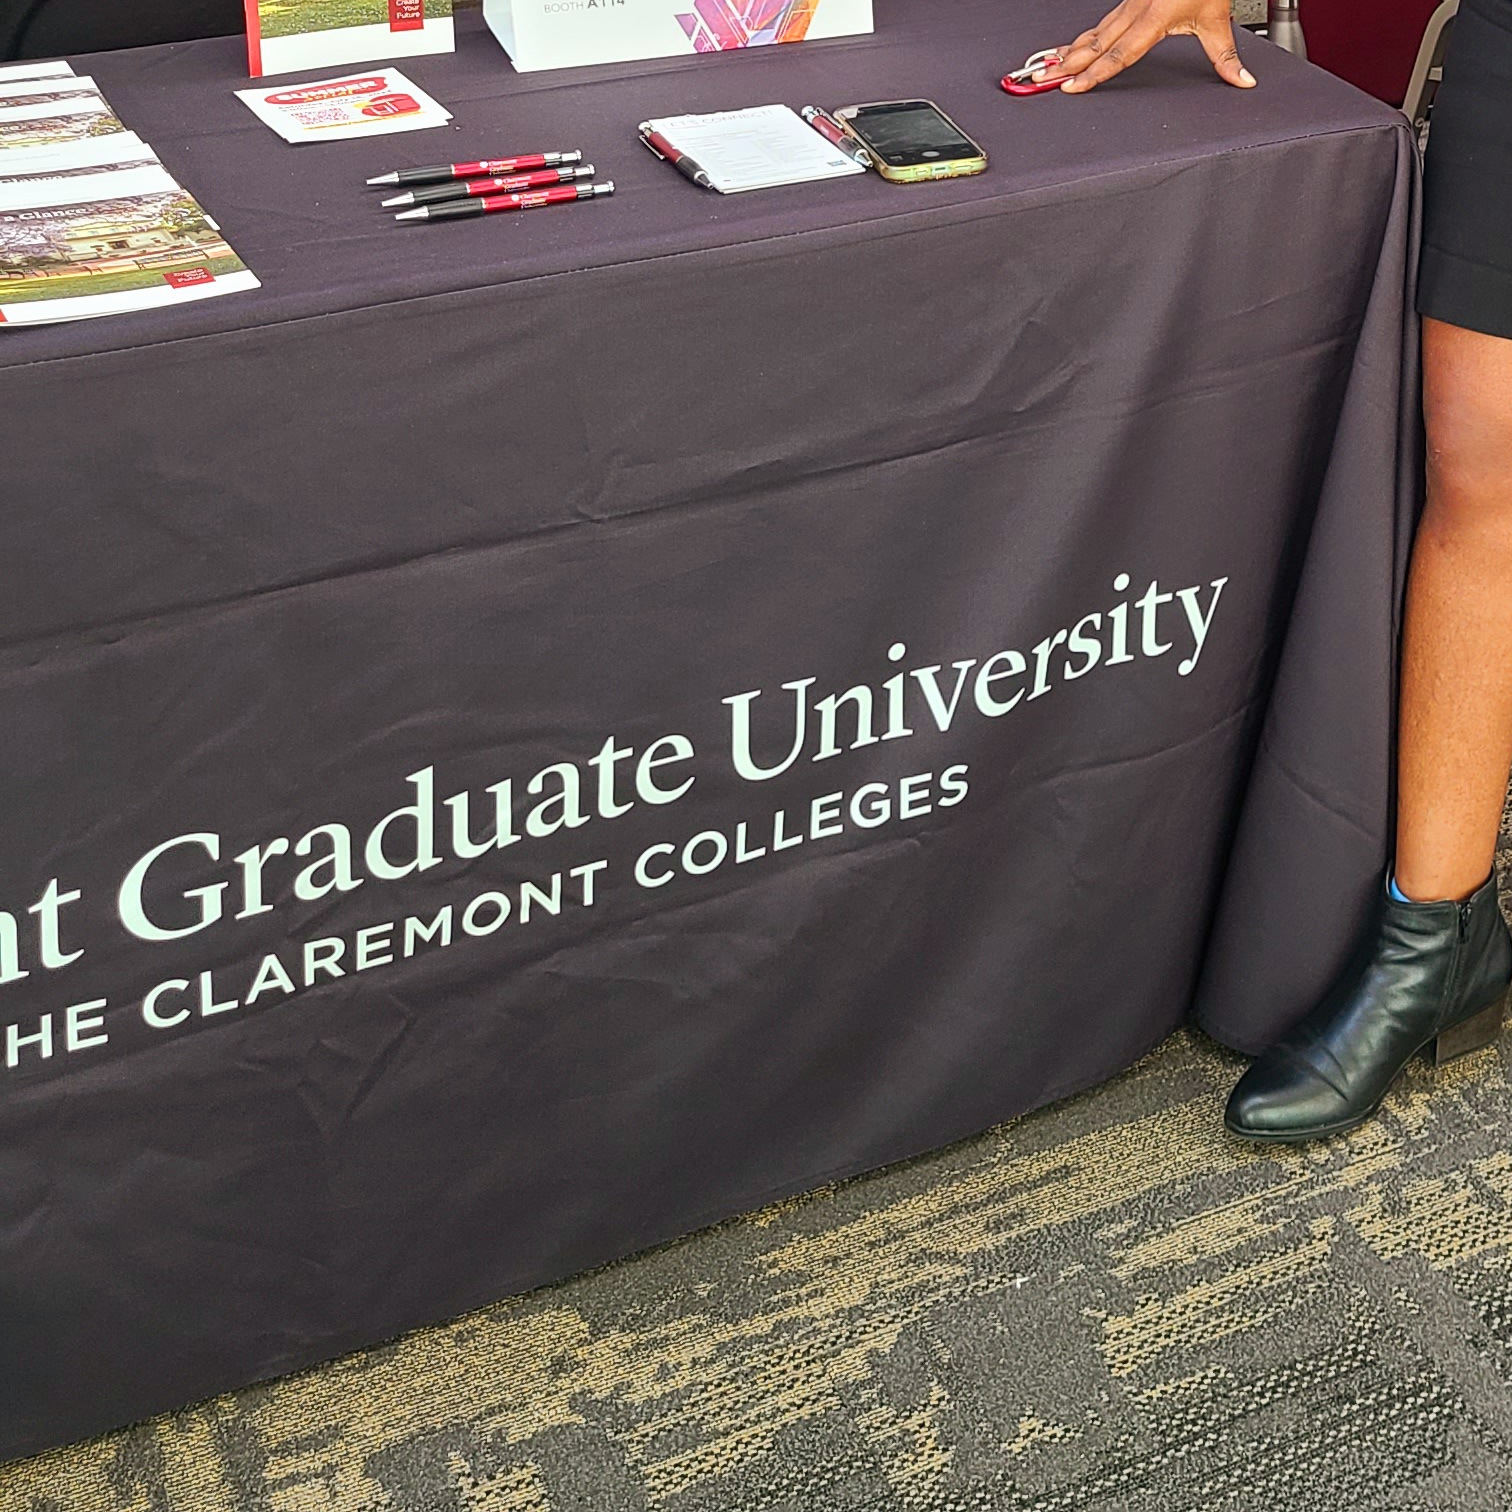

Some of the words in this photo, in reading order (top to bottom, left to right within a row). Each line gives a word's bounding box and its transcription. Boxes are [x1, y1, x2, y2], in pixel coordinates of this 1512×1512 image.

[396, 11, 421, 20] Future
[543, 0, 584, 15] BOOTH
[276, 80, 378, 101] SUMMER
[19, 208, 88, 220] Glance
[118, 734, 696, 942] Graduate
[721, 573, 1230, 781] University
[142, 859, 608, 1028] CLAREMONT
[634, 764, 969, 888] COLLEGES
